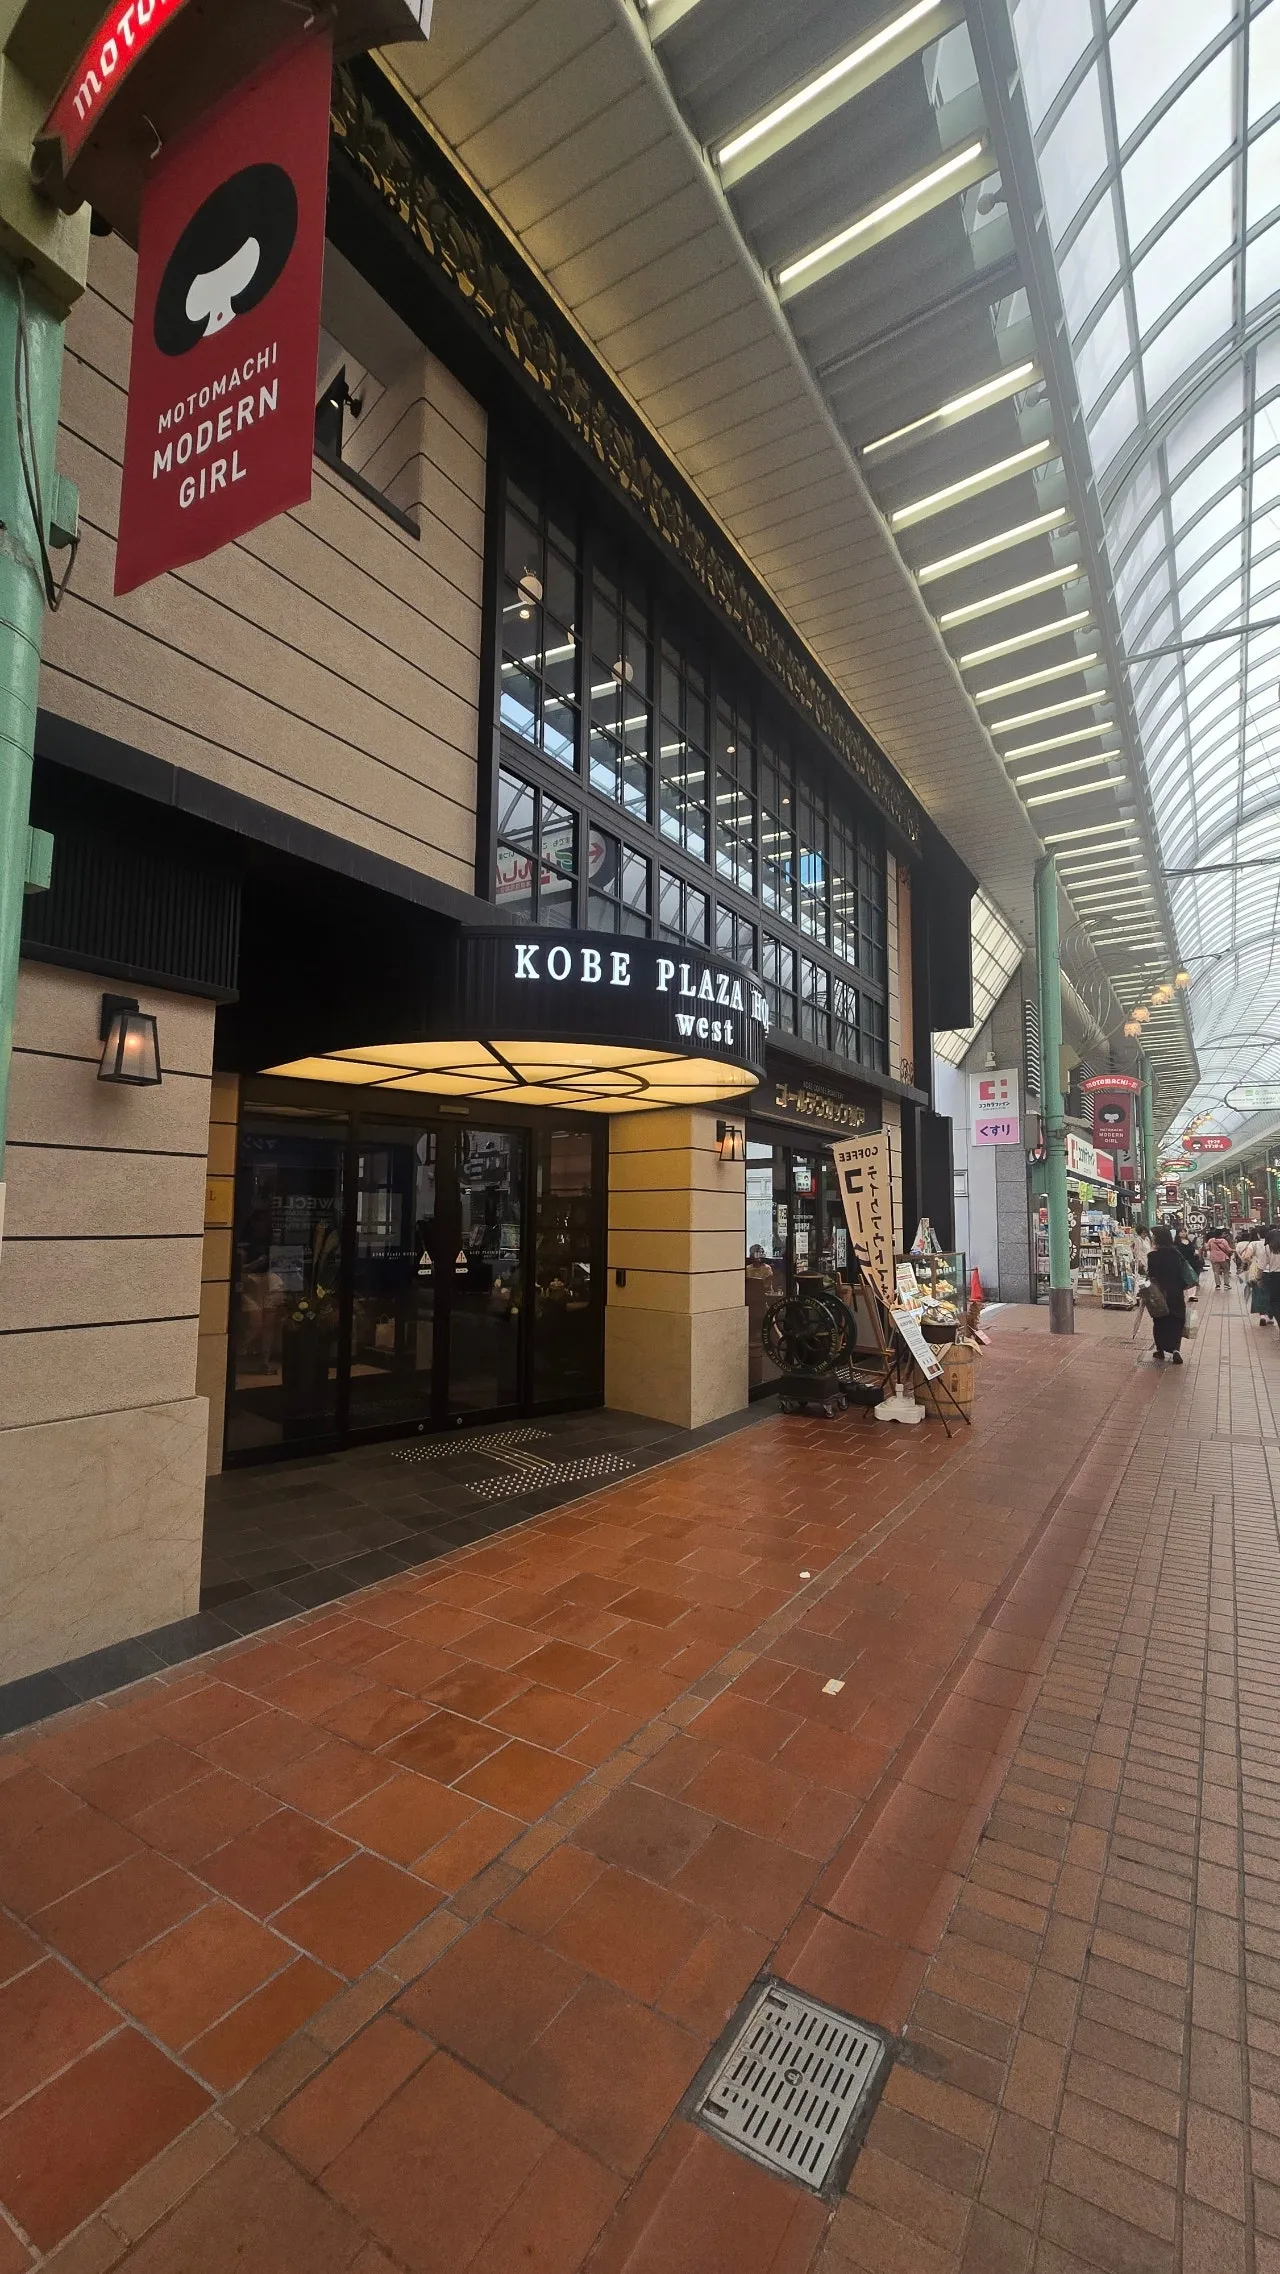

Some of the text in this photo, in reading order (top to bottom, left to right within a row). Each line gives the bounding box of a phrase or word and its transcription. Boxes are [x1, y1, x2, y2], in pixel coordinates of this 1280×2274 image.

[73, 0, 167, 120] MOTO
[158, 341, 277, 434] MOTOMACHI
[152, 378, 278, 480] MODERN
[179, 449, 247, 508] GIRL
[514, 944, 631, 986] KOBE
[655, 958, 744, 1012] PLAZA
[674, 1013, 734, 1046] west
[979, 1124, 1011, 1137] くすり
